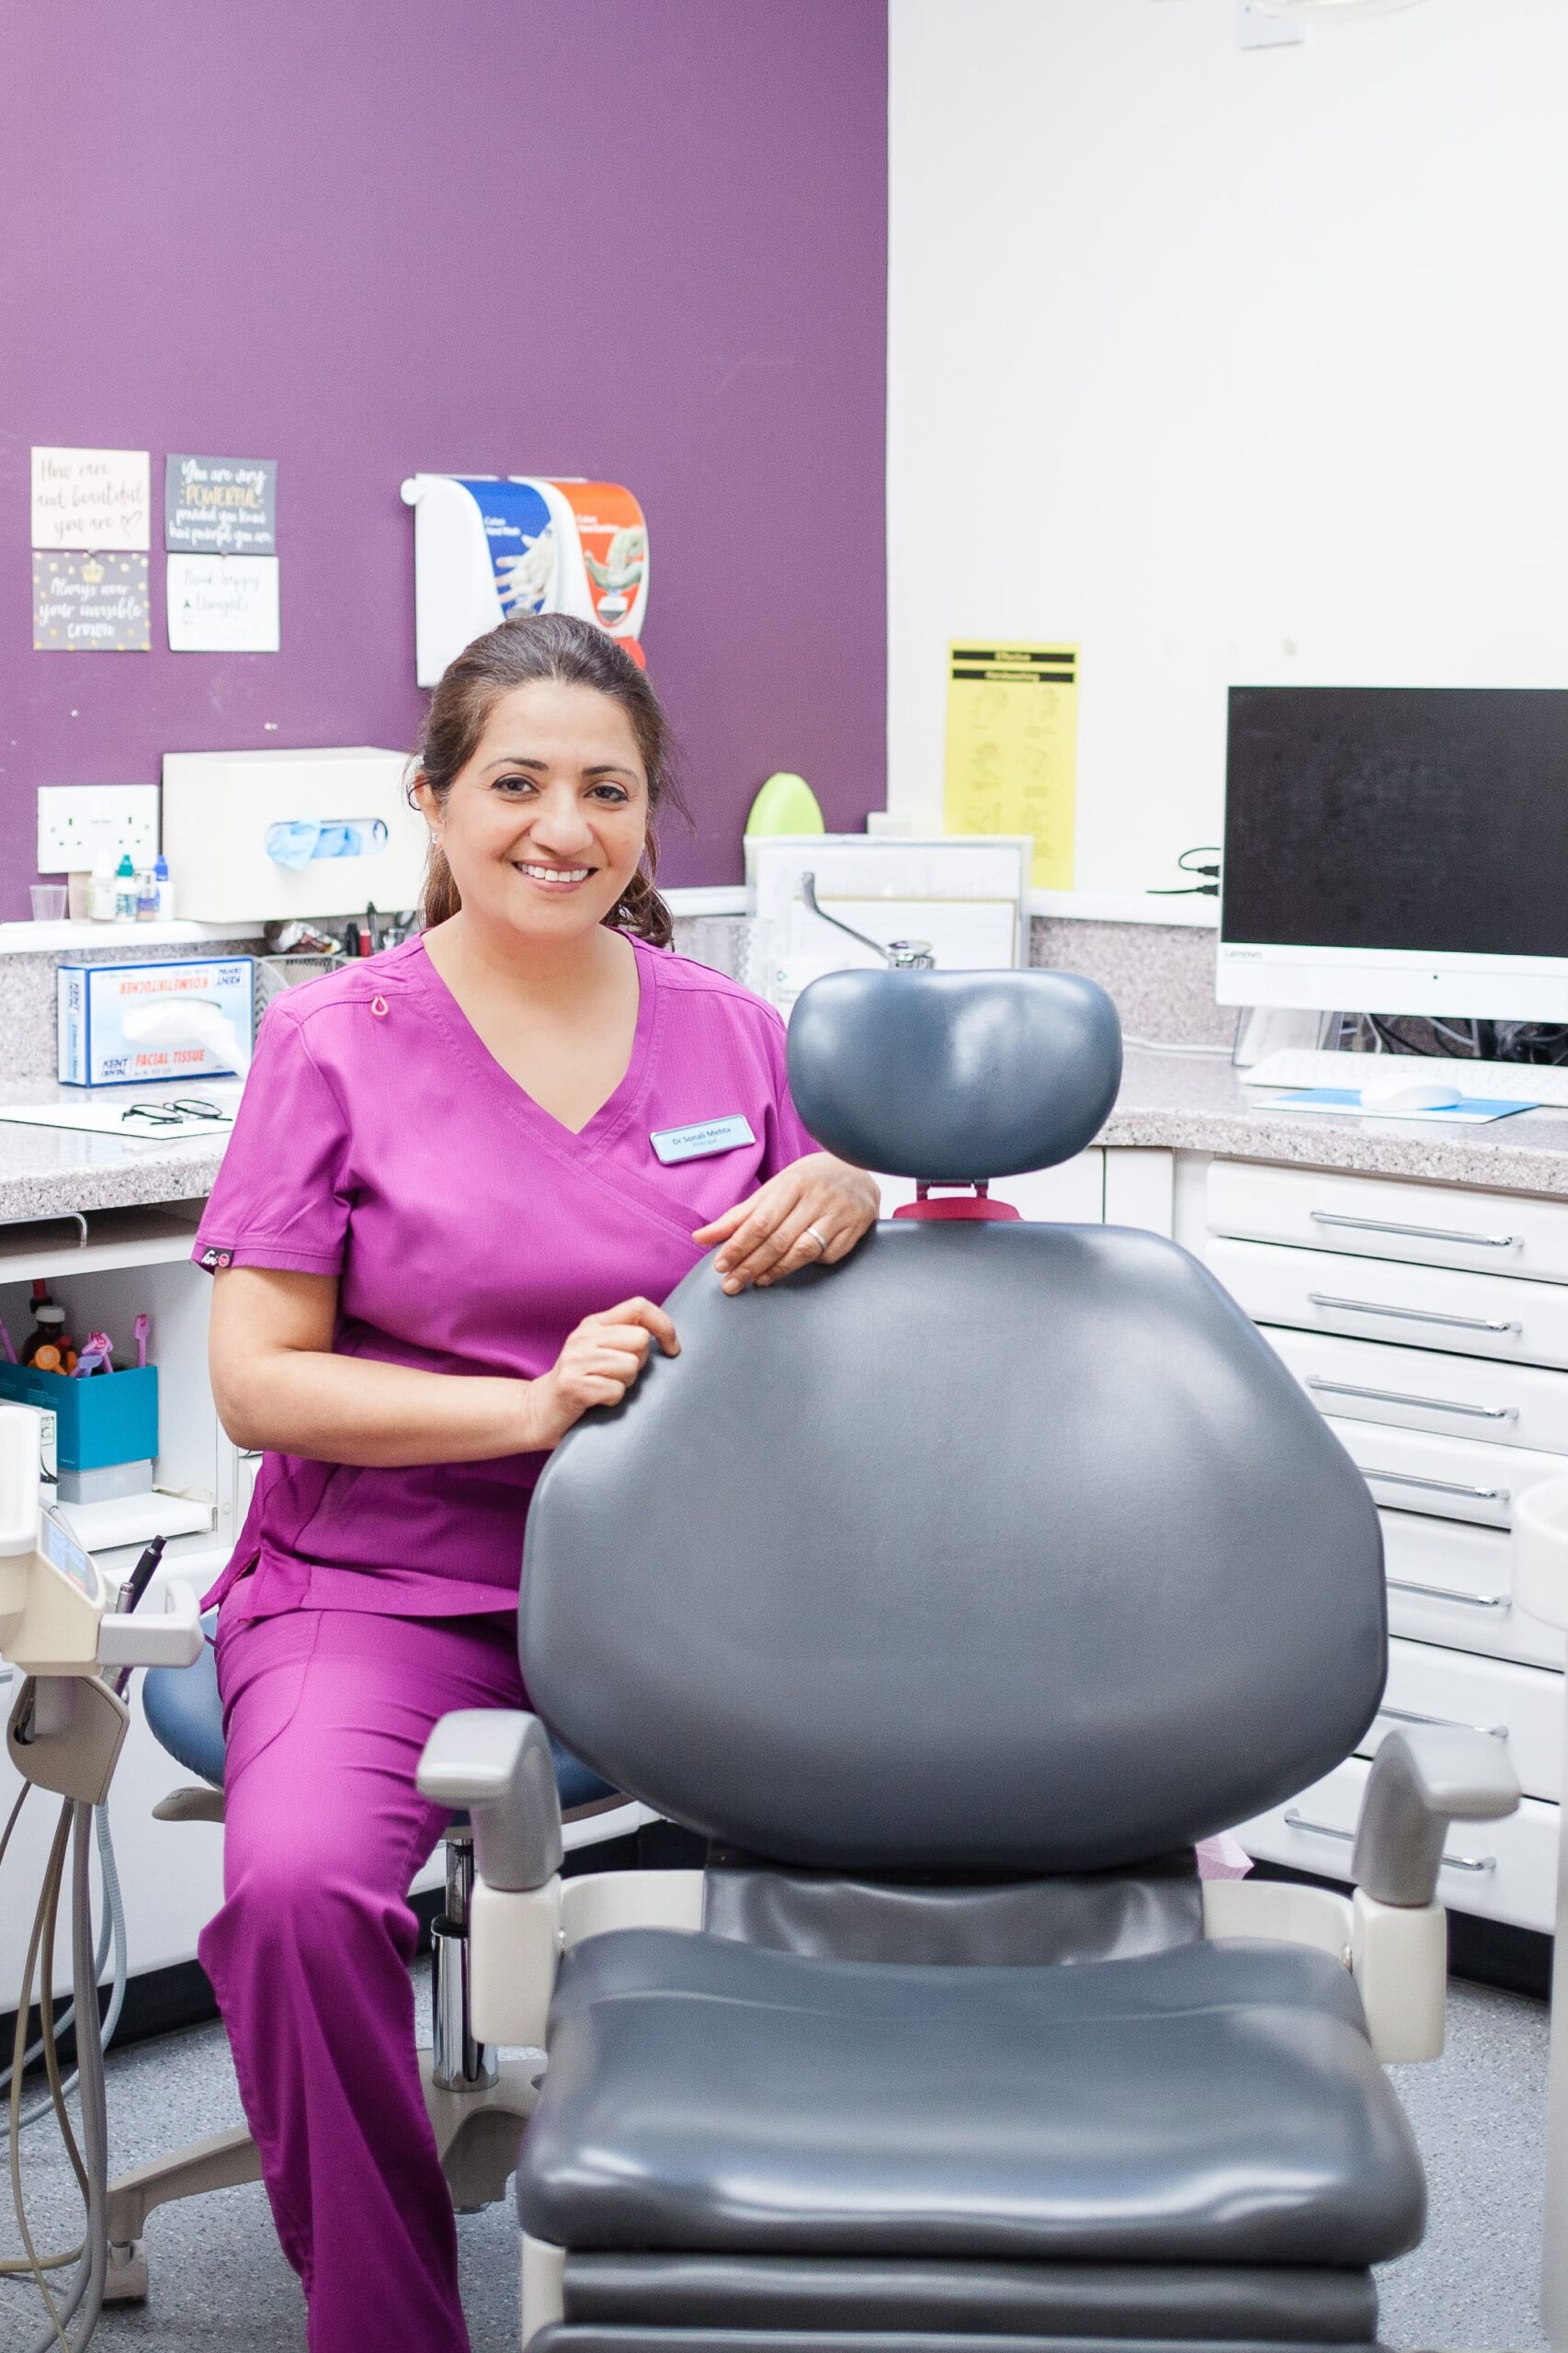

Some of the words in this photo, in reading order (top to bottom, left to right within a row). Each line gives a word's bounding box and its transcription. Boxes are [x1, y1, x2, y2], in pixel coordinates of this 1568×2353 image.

[40, 456, 72, 482] How
[79, 463, 111, 476] rare
[182, 460, 208, 483] You
[210, 470, 233, 483] are
[235, 469, 267, 495] very
[38, 485, 65, 509] and
[73, 479, 143, 508] beautiful
[54, 517, 84, 543] you
[89, 517, 115, 530] are
[51, 577, 97, 602] Always
[101, 584, 131, 596] wear
[40, 603, 74, 627] your
[80, 596, 142, 620] invisible
[67, 622, 116, 639] crown
[102, 1058, 129, 1068] KENT
[135, 1051, 168, 1067] FACIAL
[173, 1049, 206, 1063] TISSUE
[672, 1138, 681, 1146] Dr
[682, 1132, 706, 1143] Sonali
[706, 1127, 732, 1139] Mehta
